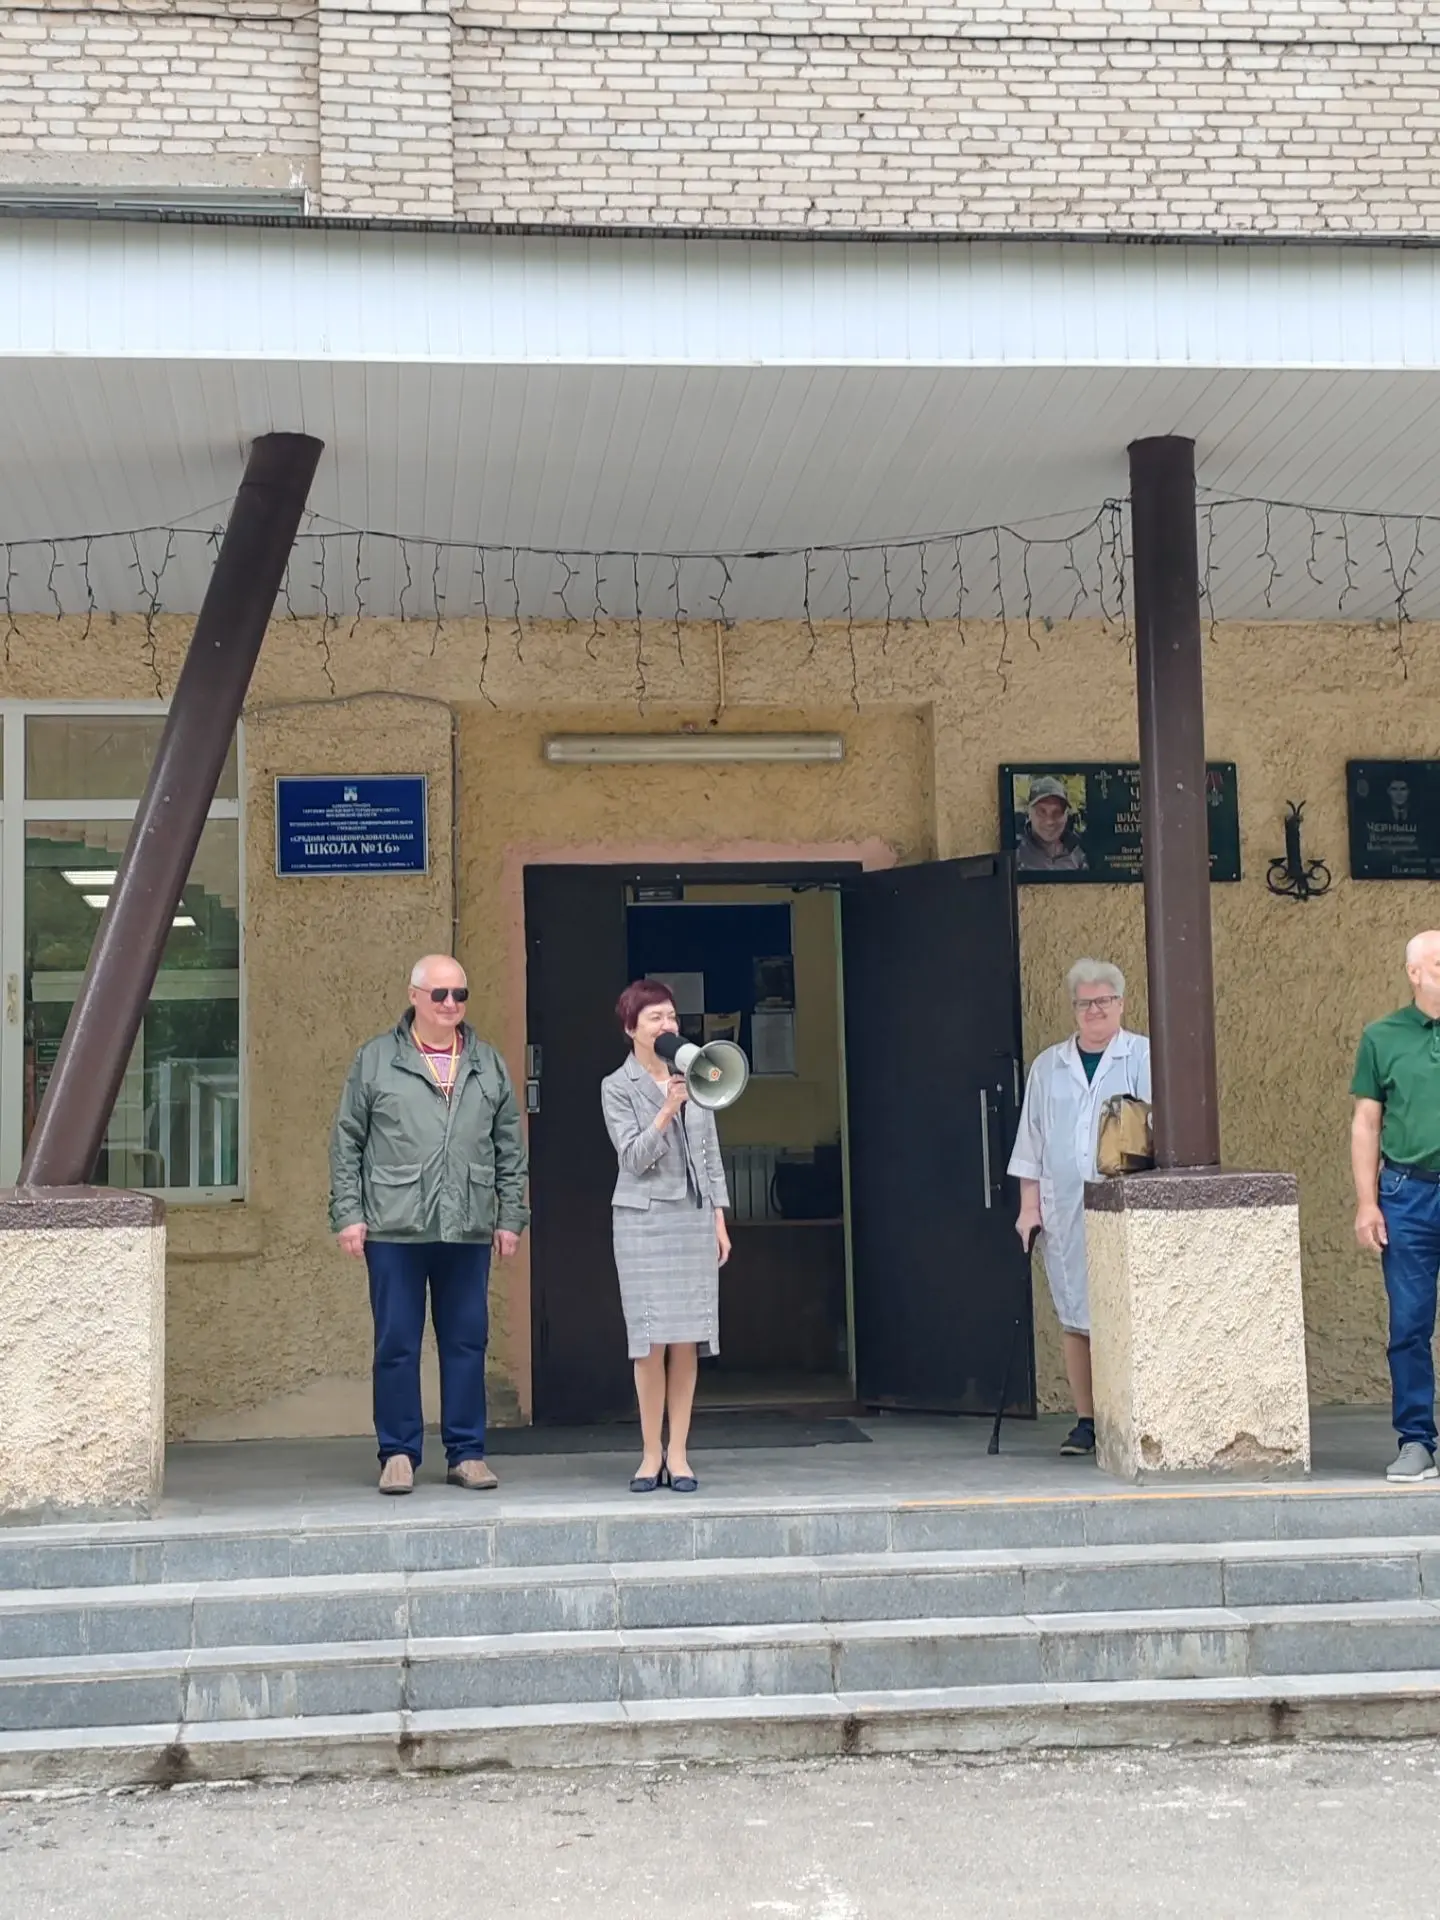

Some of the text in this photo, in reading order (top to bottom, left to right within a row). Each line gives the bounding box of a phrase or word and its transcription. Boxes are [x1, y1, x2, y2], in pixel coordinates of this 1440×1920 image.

[326, 833, 414, 842] ОБЩЕОБРАЗОВАТЕЛЬНАЯ
[304, 842, 401, 856] ШКОЛА №16»
